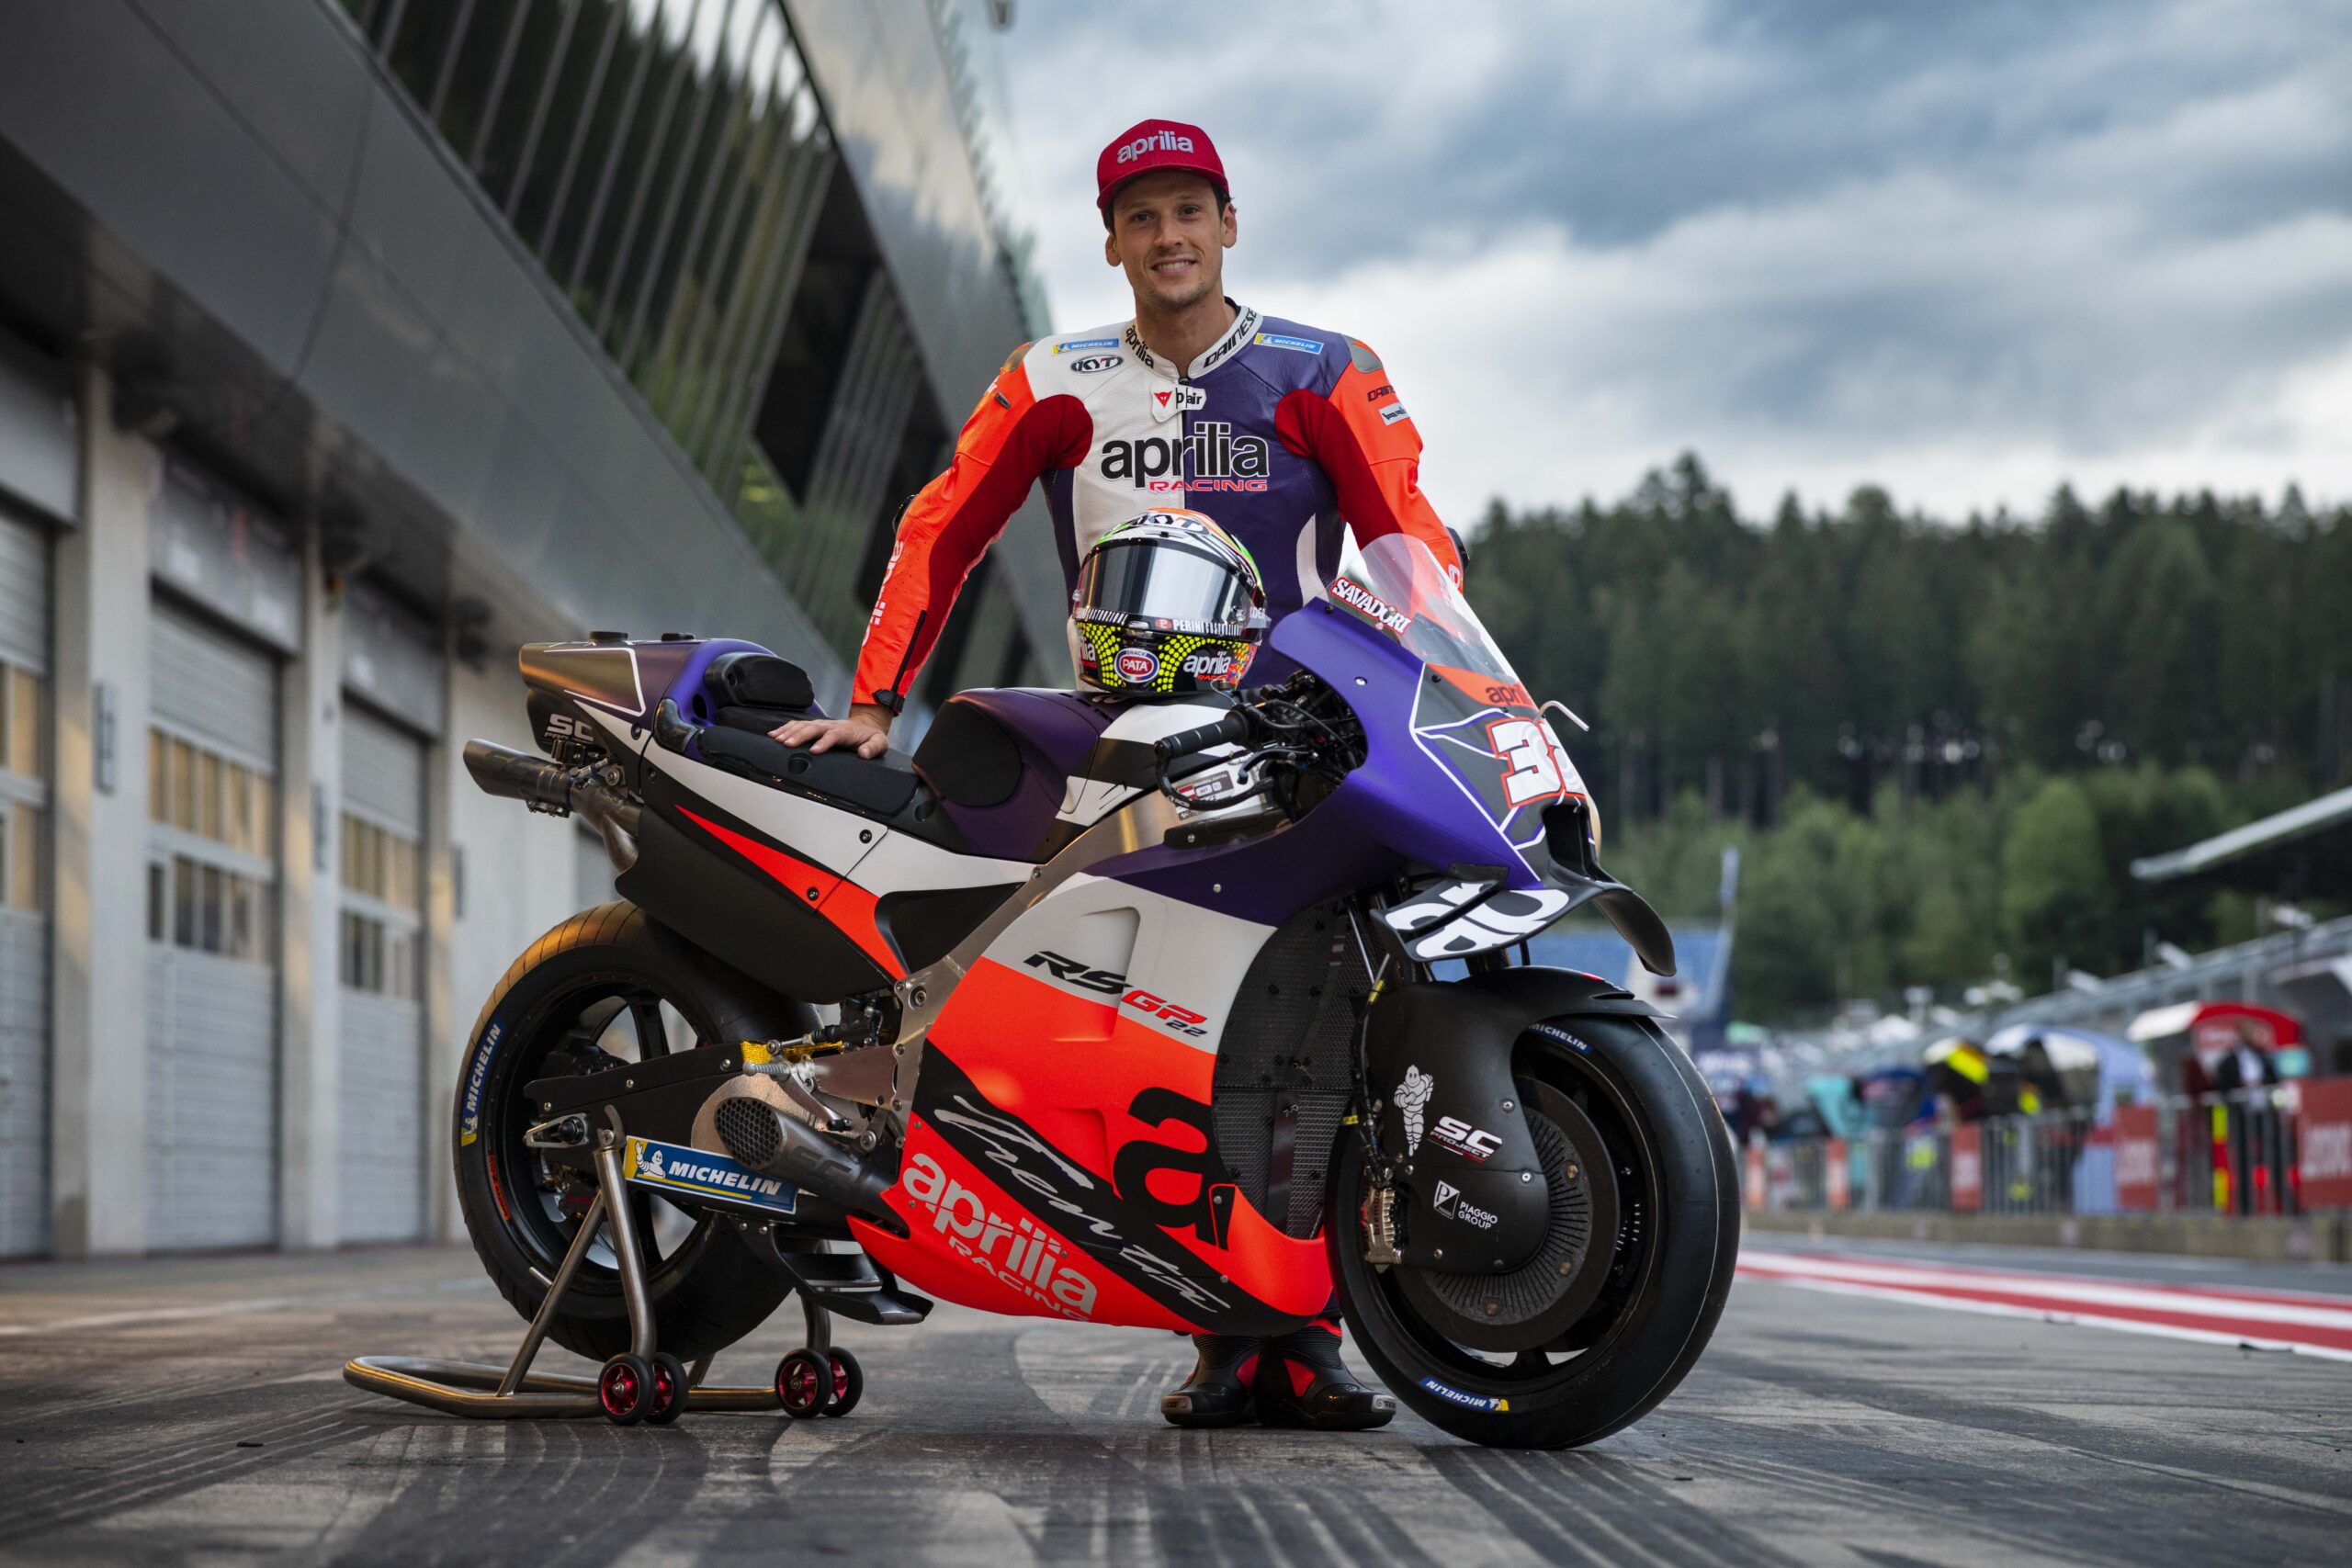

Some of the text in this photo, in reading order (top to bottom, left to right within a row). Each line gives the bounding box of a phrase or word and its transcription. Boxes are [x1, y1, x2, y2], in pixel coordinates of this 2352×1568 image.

[1117, 130, 1193, 164] aprilia
[1071, 341, 1114, 349] MICHELIN
[1125, 324, 1155, 369] aprilia
[1204, 308, 1258, 368] DAINESE
[1273, 338, 1317, 350] MICHELIN
[1101, 422, 1270, 490] aprilia
[1148, 479, 1268, 491] RACING
[1331, 579, 1412, 634] SAVADORI
[1123, 659, 1148, 672] PATA
[1183, 651, 1232, 678] aprilia
[465, 1023, 501, 1113] MICHELIN
[1429, 1131, 1491, 1158] PROJECT
[1434, 1116, 1503, 1155] SC
[669, 1161, 782, 1195] MICHELIN
[1457, 1210, 1492, 1230] GROUP
[1459, 1201, 1498, 1224] PIAGGIO
[902, 1153, 1098, 1315] aprilia
[1426, 1381, 1487, 1407] MICHELIN
